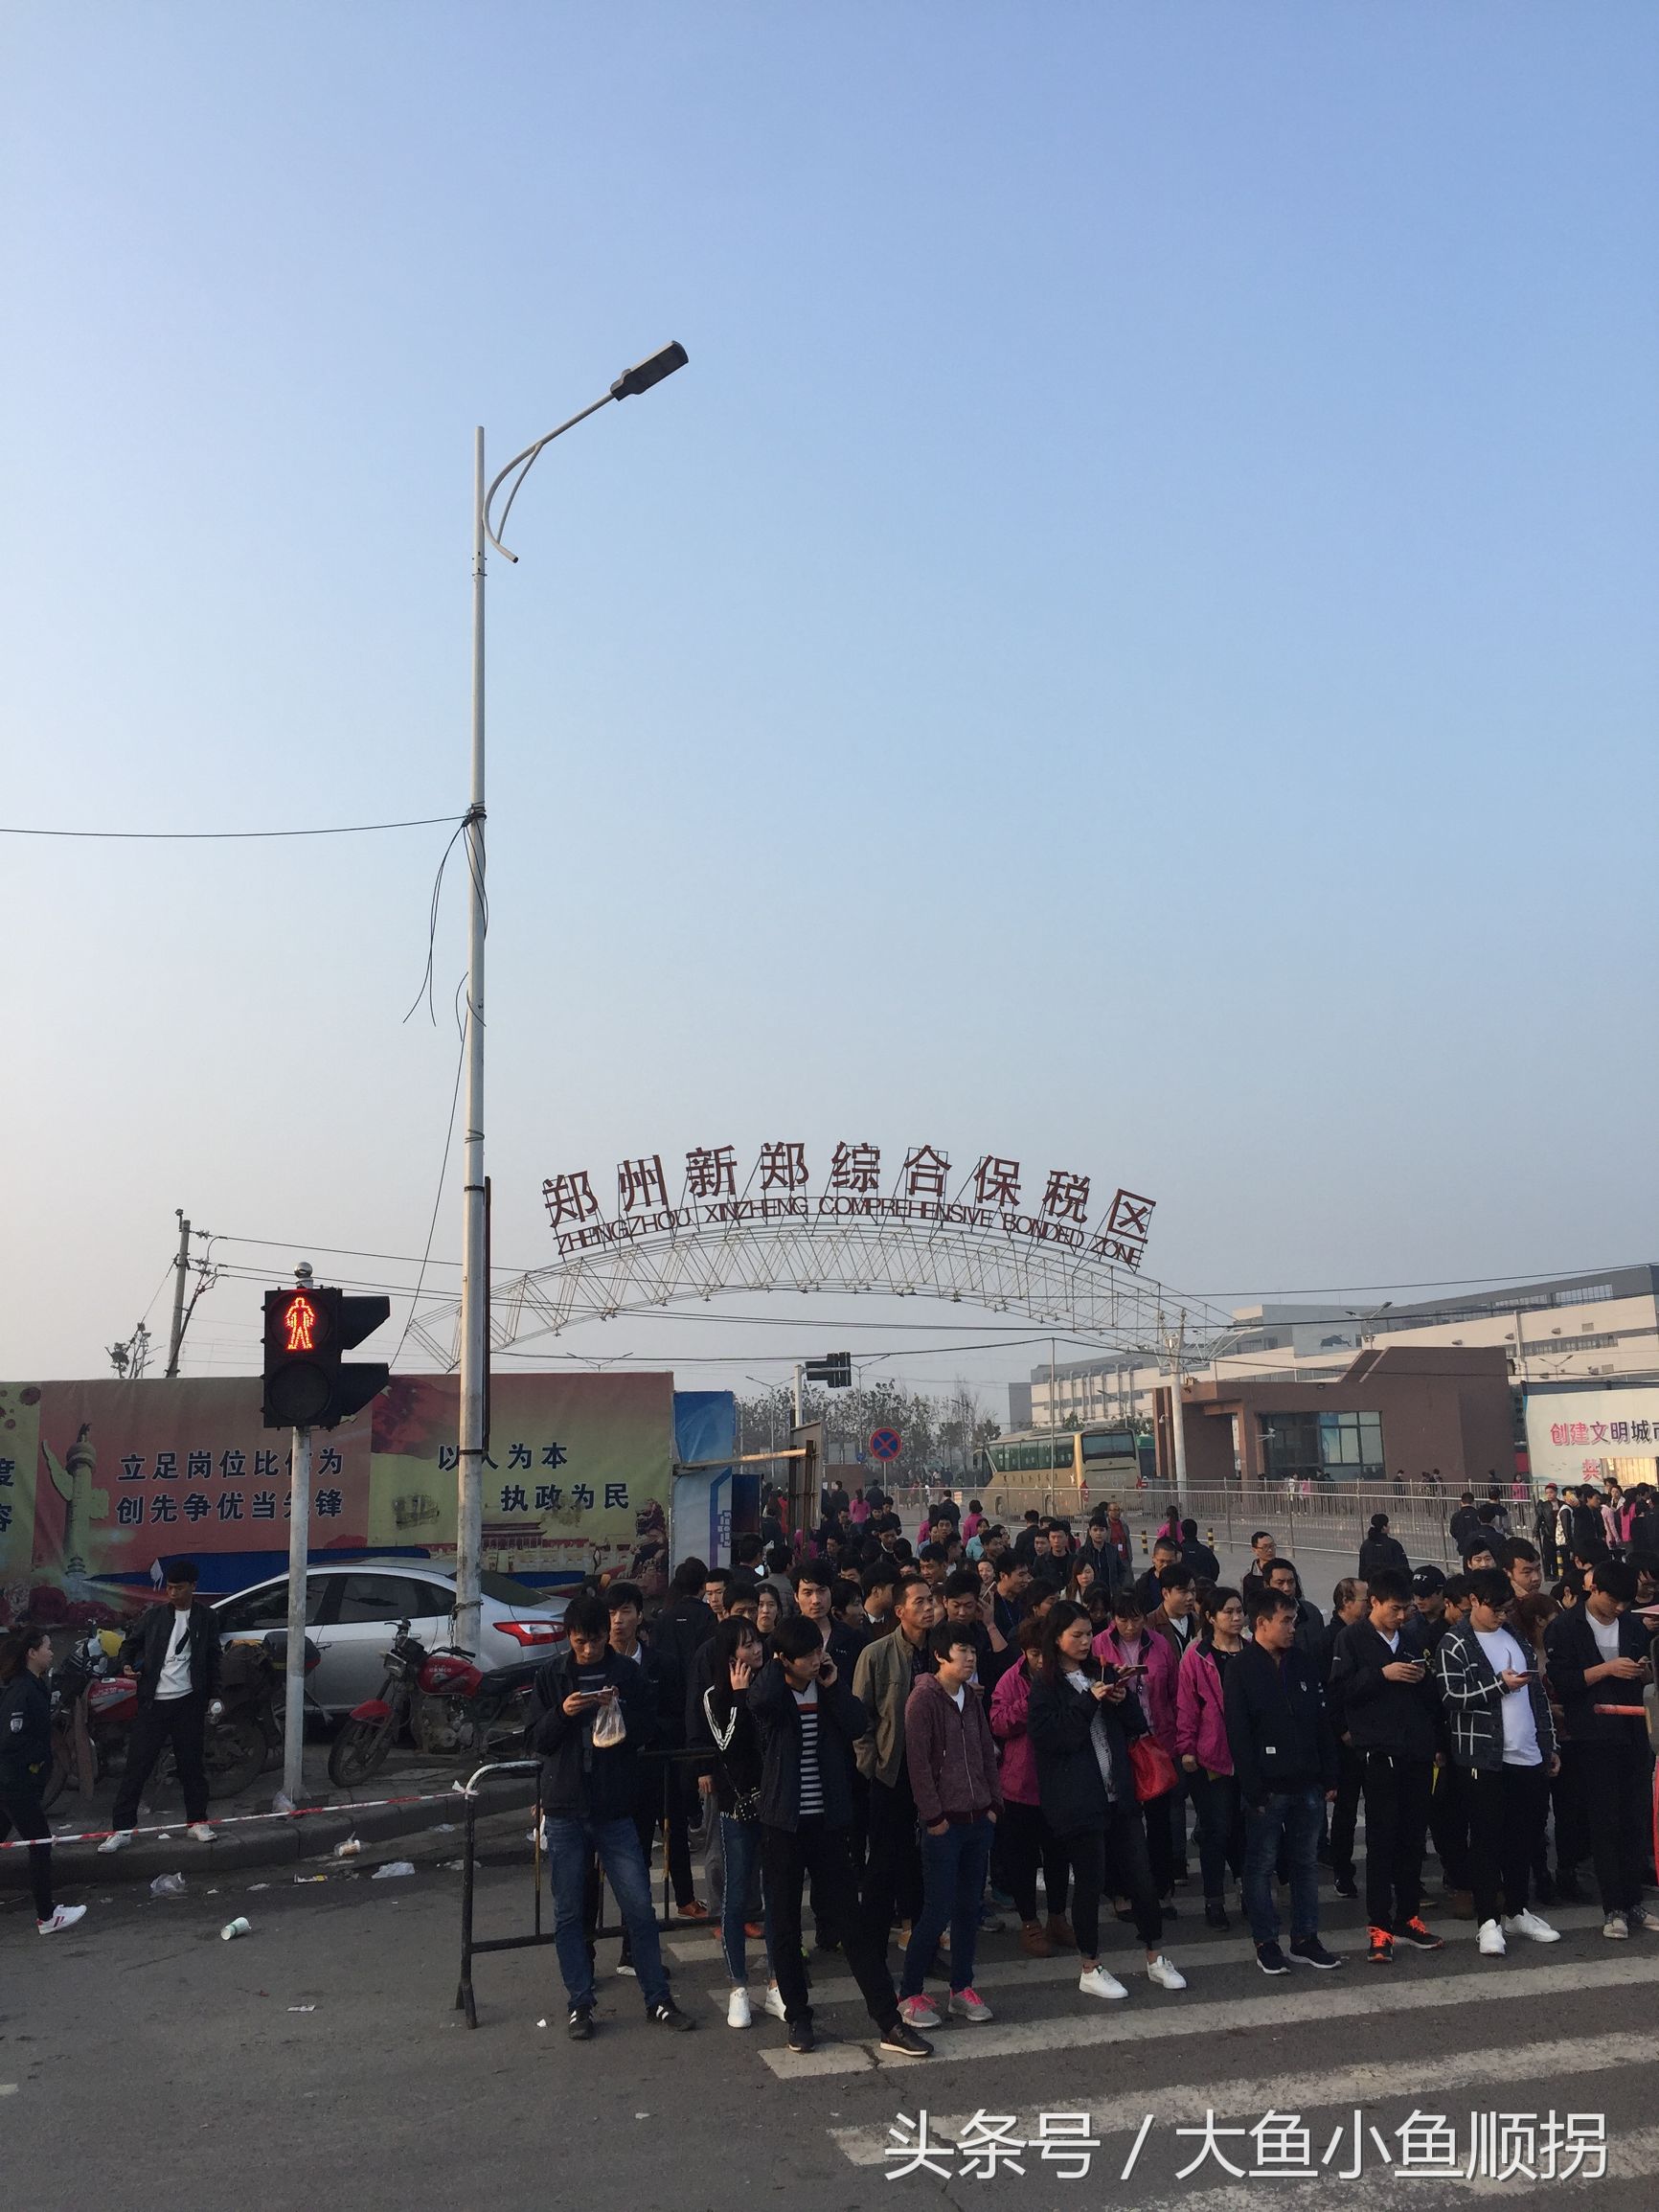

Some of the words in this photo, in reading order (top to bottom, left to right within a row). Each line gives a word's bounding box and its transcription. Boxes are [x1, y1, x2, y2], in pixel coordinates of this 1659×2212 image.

[542, 1141, 1156, 1243] 郑州新郑综合保税区
[554, 1207, 691, 1255] ZHENGZHOU
[705, 1196, 808, 1222] XINZHENG
[819, 1196, 994, 1228] COMPREHENSIVE
[1002, 1213, 1084, 1247] BONDED
[1090, 1235, 1144, 1268] ZONE
[500, 1483, 629, 1512] 执政为民
